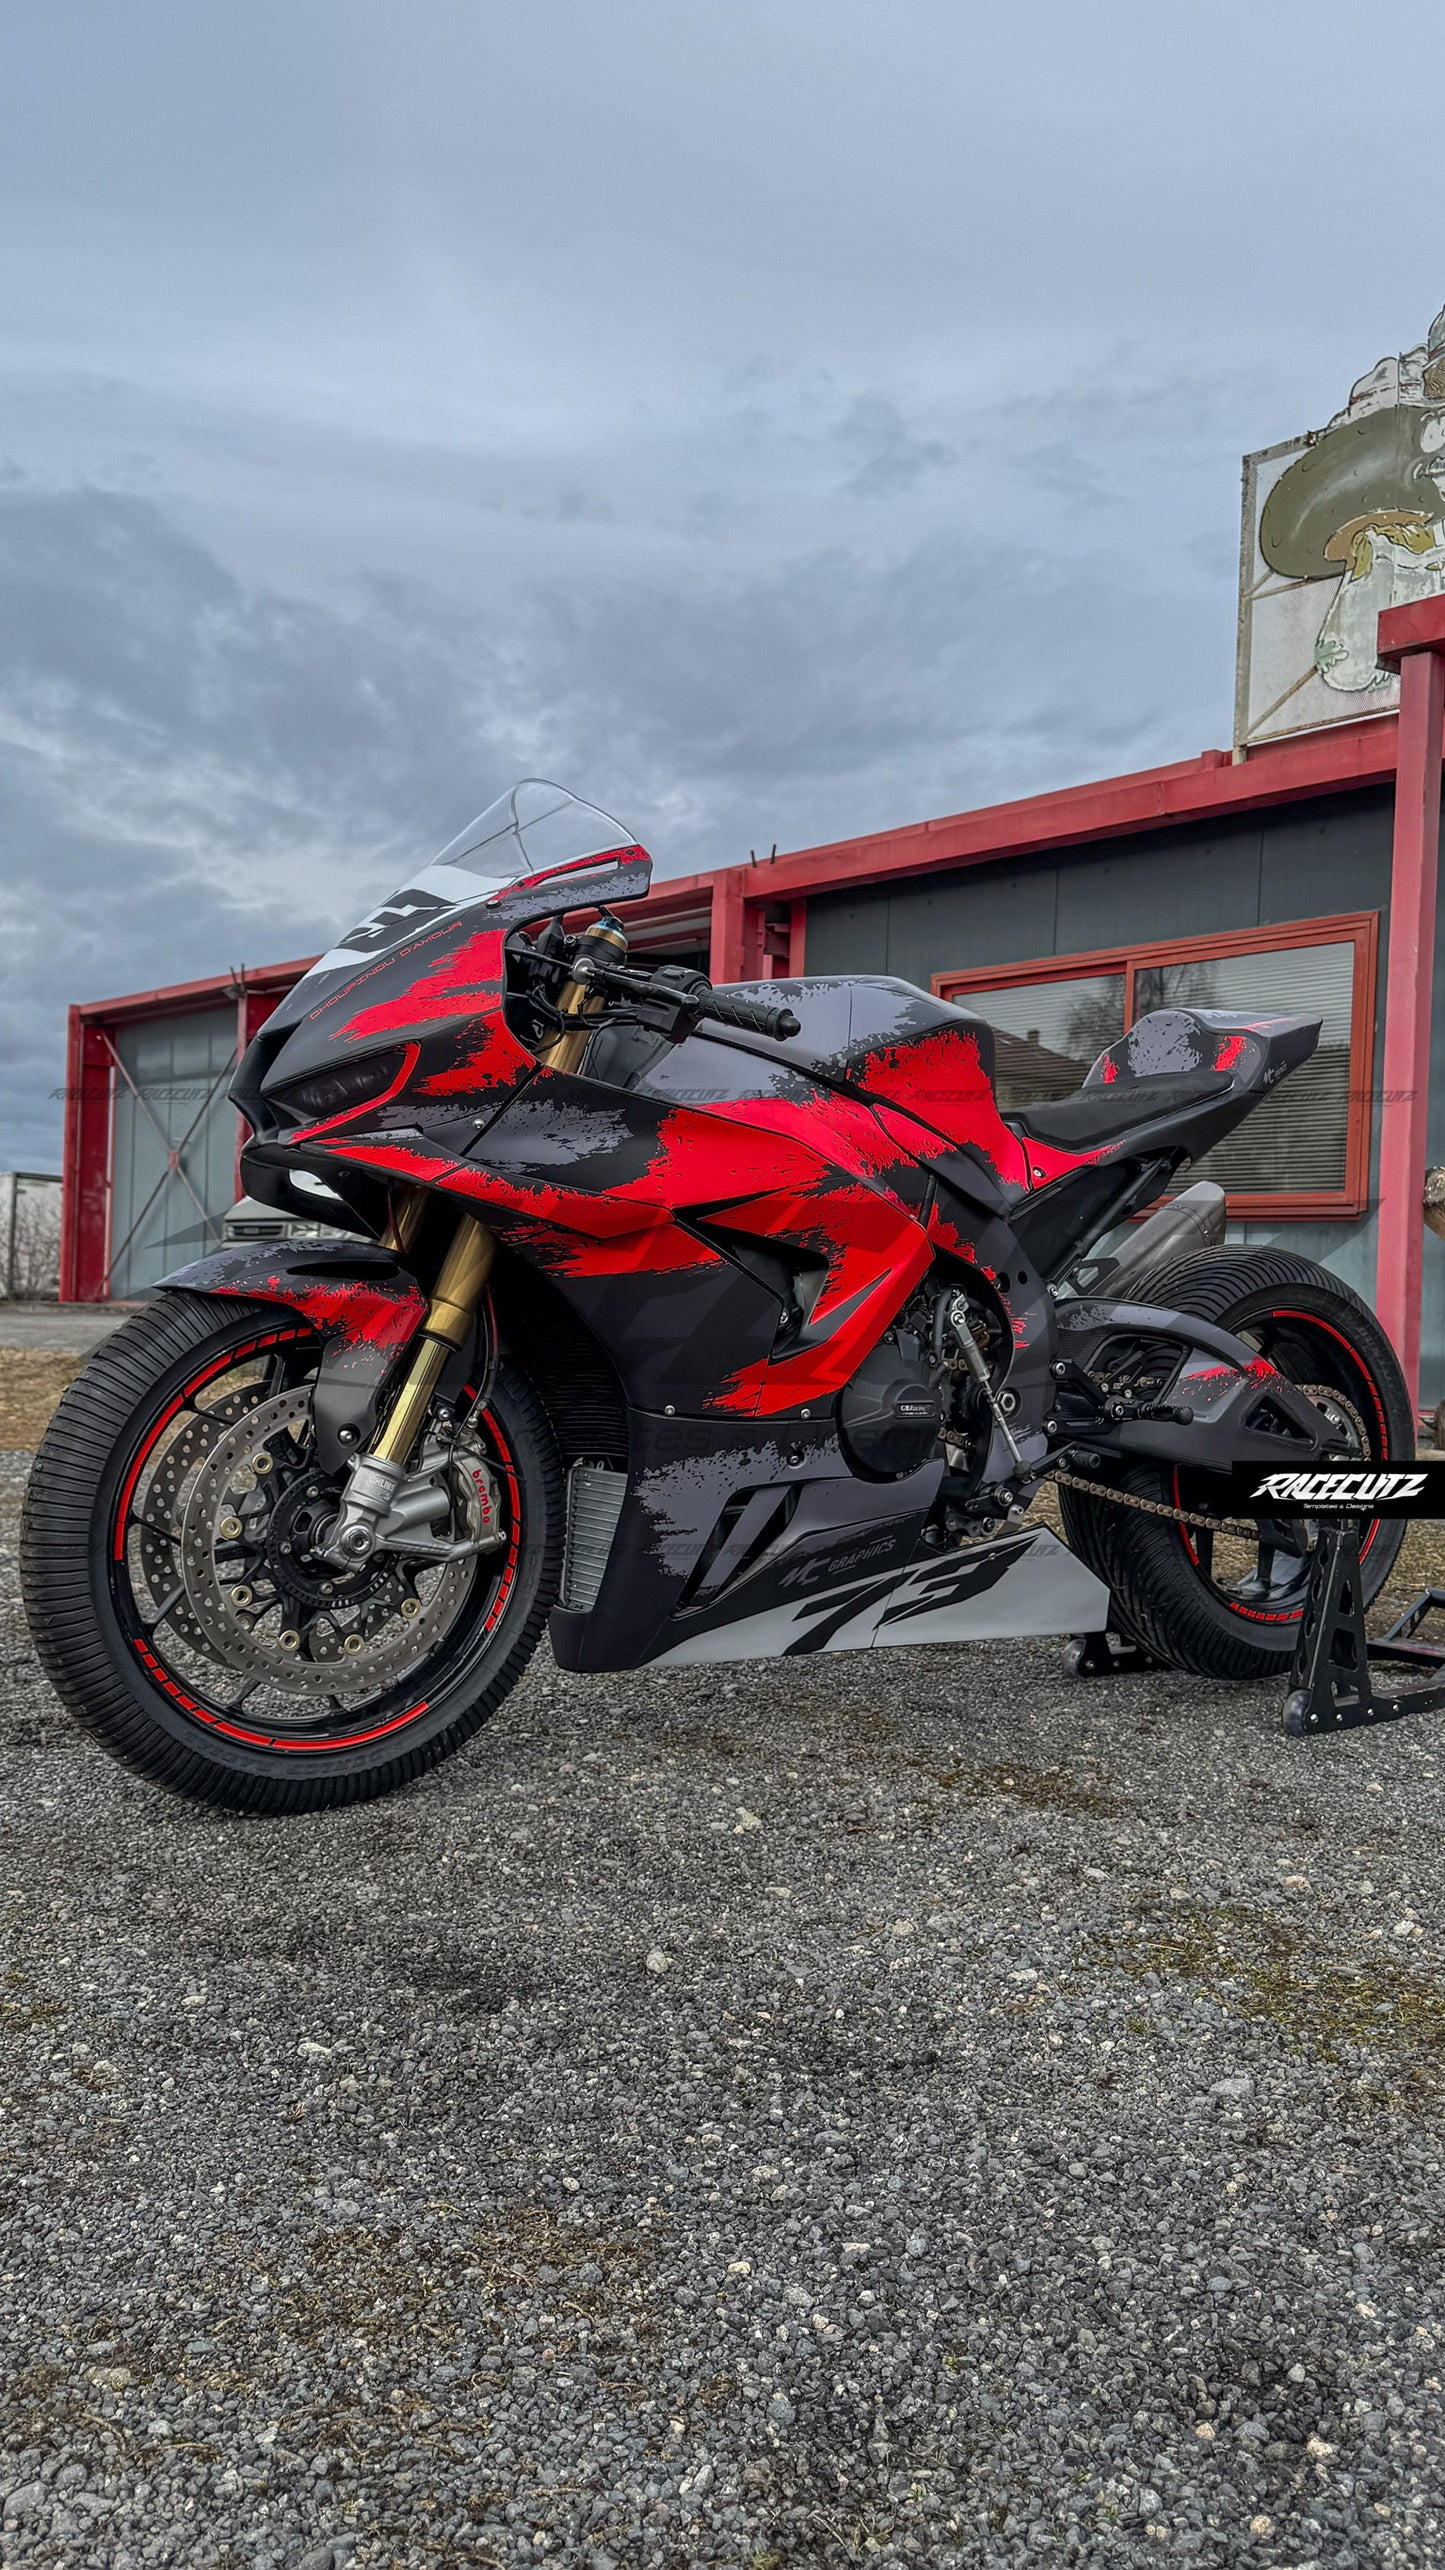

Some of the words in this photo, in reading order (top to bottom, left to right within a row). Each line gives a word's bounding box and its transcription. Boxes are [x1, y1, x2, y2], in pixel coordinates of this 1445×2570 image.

[310, 957, 396, 1020] CHOUPINOU
[472, 1469, 493, 1524] brembo
[827, 1539, 896, 1573] GRAPHICS
